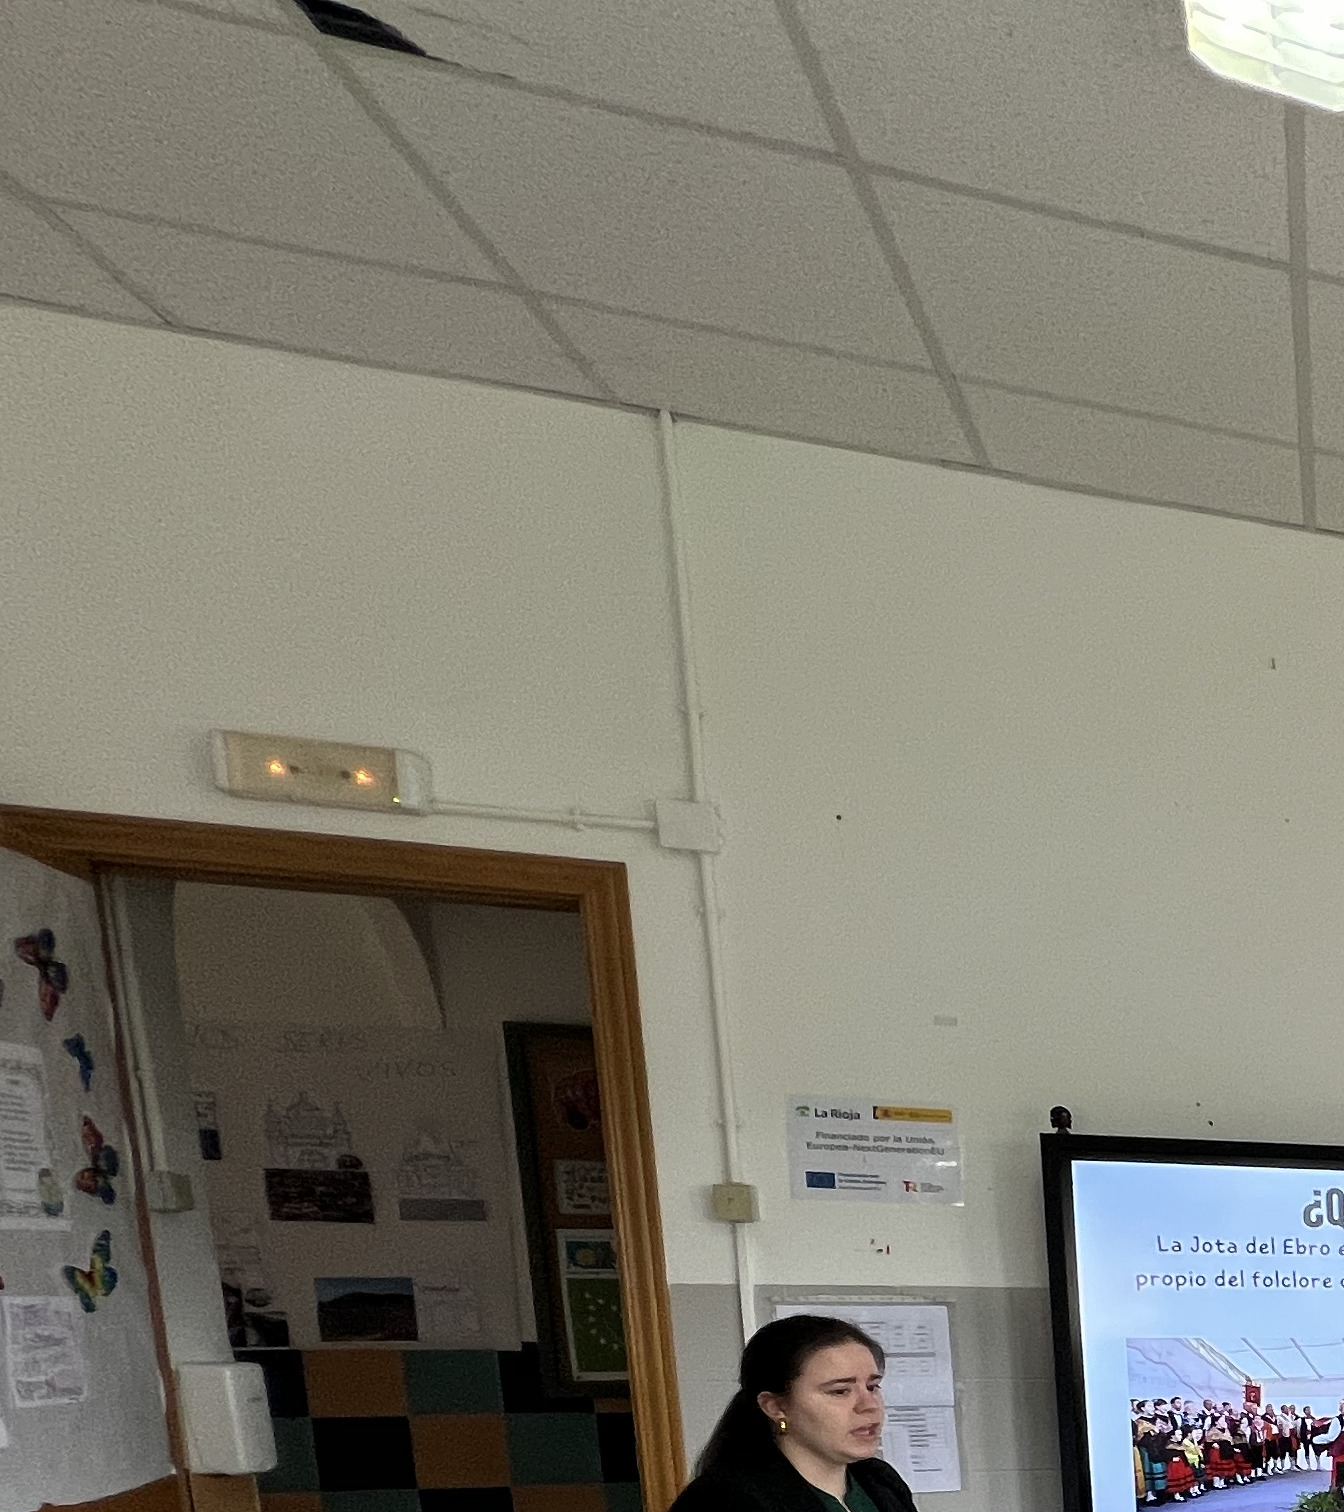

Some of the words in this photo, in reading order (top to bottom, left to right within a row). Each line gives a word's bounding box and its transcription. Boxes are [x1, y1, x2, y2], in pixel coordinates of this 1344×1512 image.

[814, 1107, 828, 1118] La
[830, 1108, 861, 1121] Rioja
[1156, 1235, 1182, 1252] La
[1190, 1236, 1238, 1254] Jota
[1246, 1236, 1275, 1255] del
[1283, 1238, 1331, 1256] Ebro
[1135, 1270, 1207, 1291] propio
[1214, 1270, 1245, 1288] del
[1252, 1270, 1333, 1289] folclore
